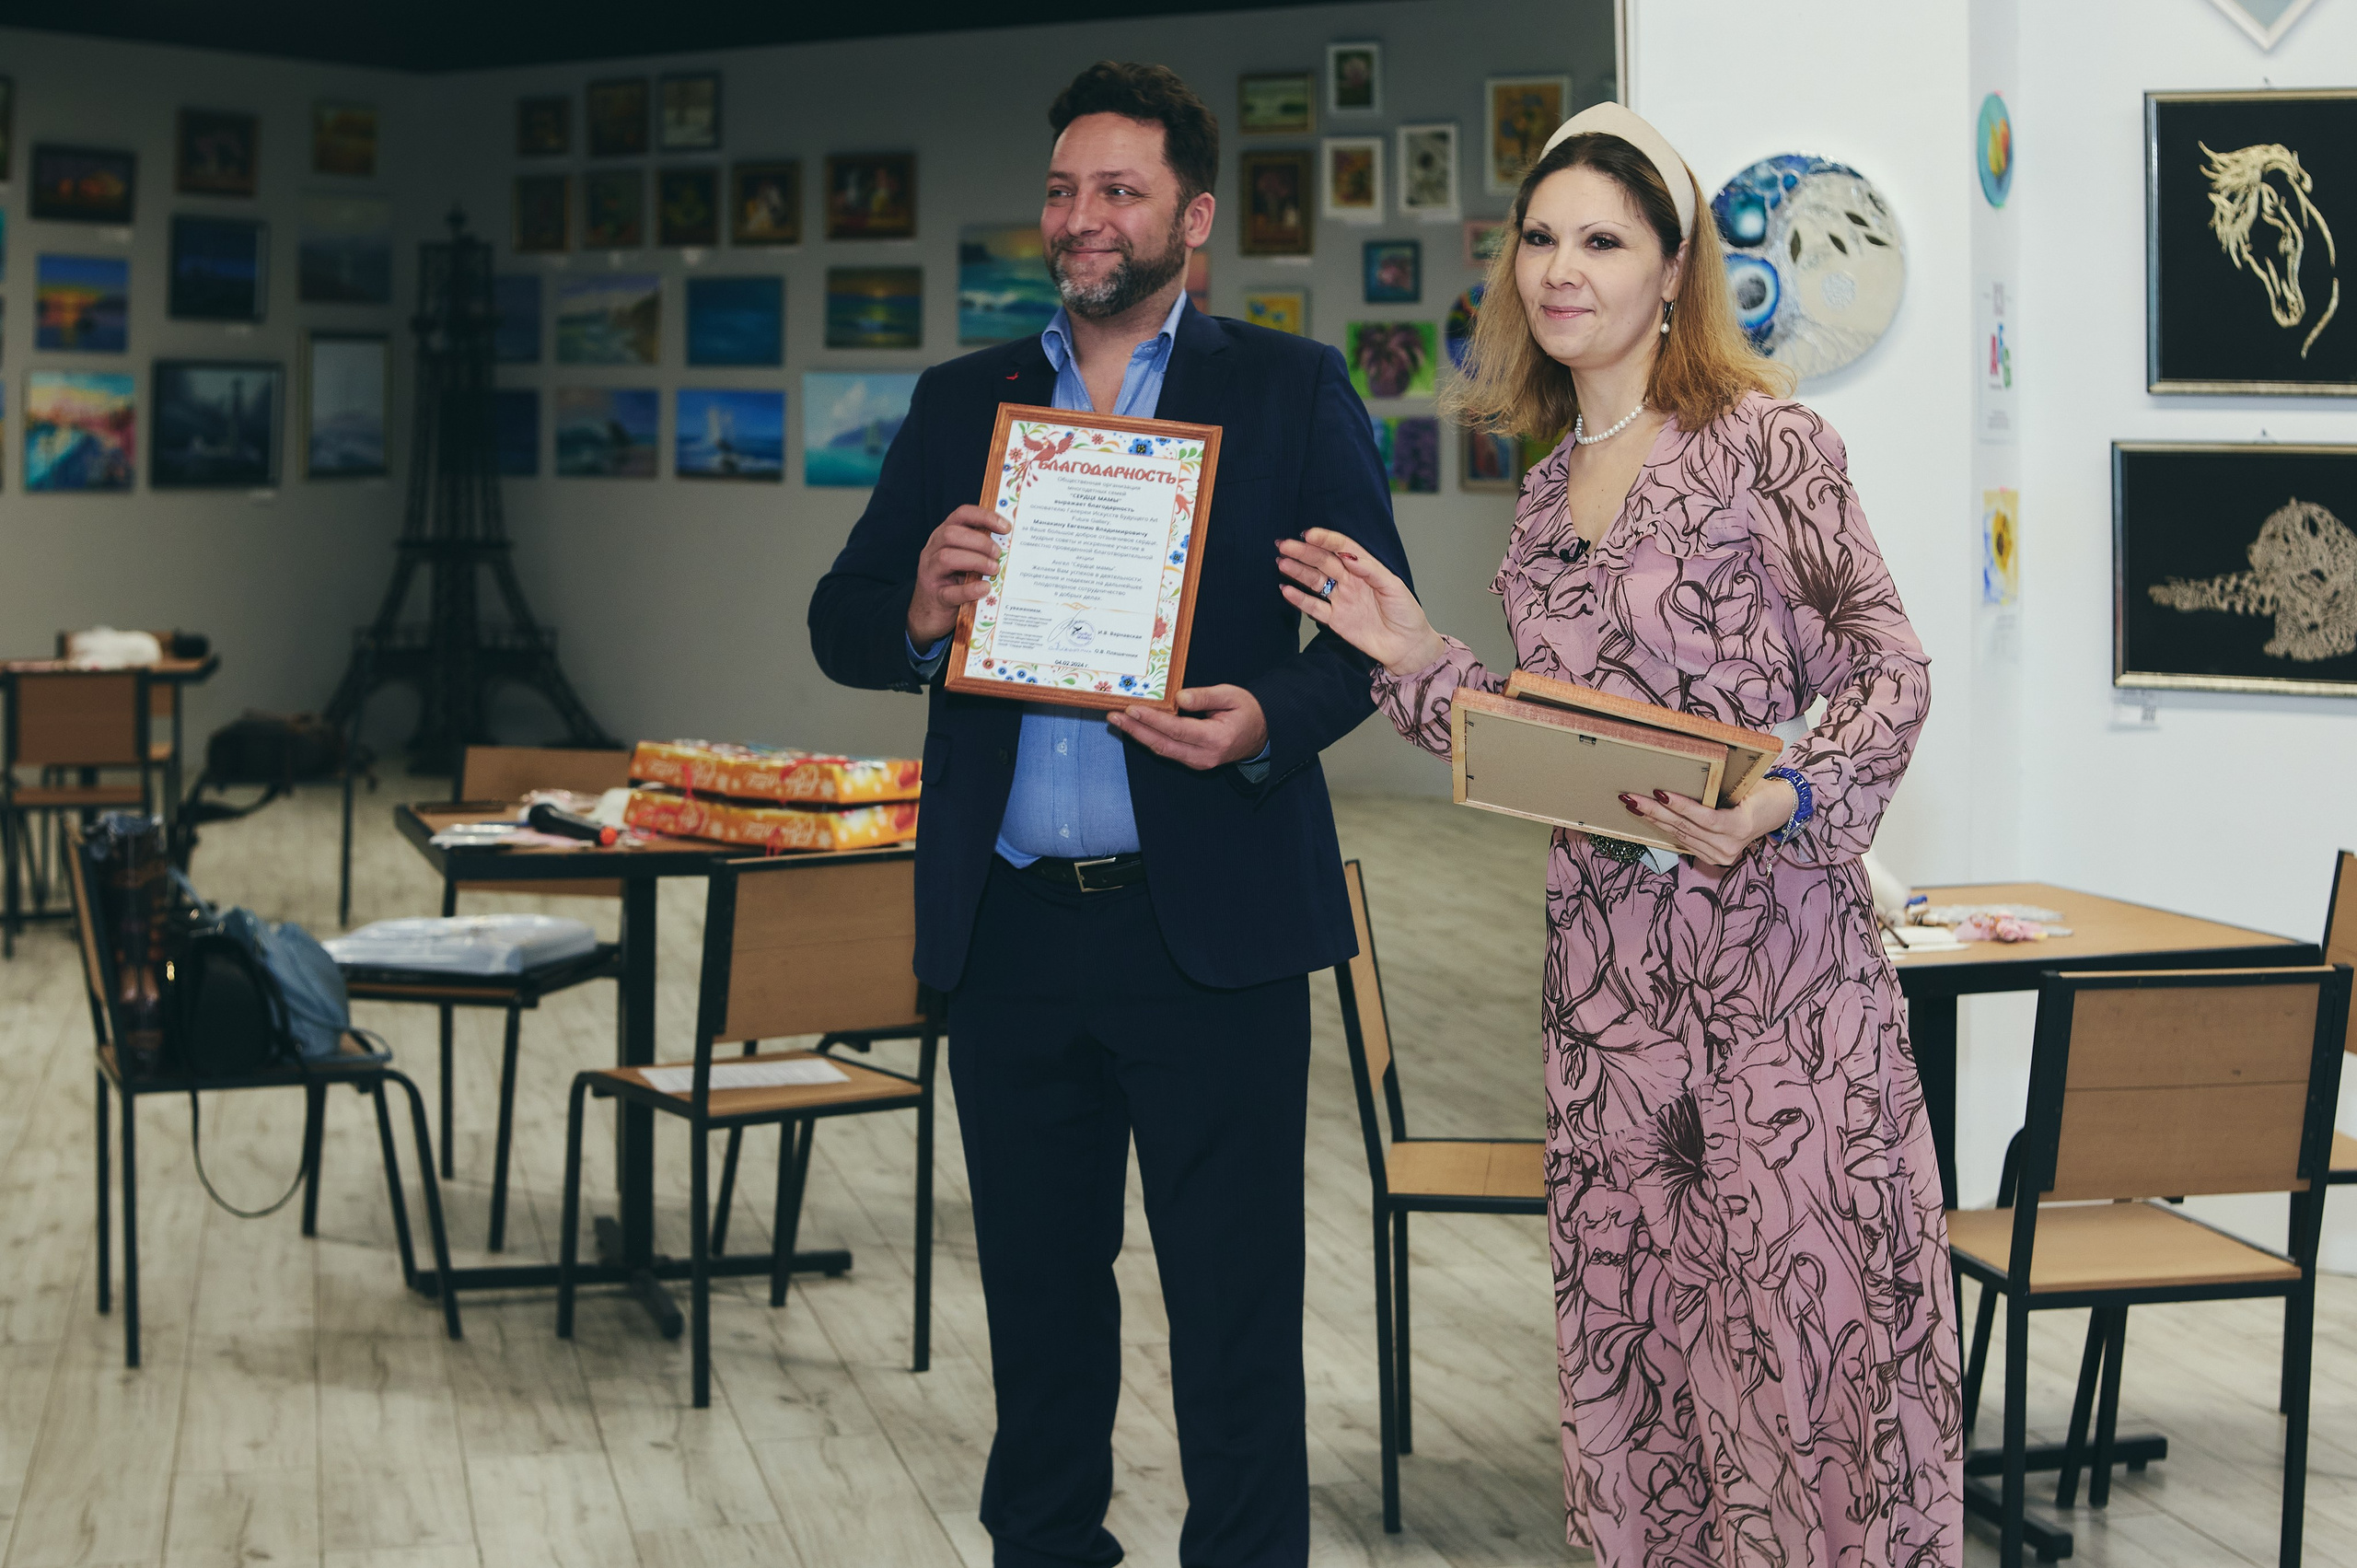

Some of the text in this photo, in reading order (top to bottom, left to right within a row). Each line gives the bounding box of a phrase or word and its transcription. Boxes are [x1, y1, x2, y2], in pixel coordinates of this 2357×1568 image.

[1038, 459, 1177, 484] БЛАГОДАРНОСТЬ
[1057, 476, 1141, 491] Общественная организация
[1067, 507, 1091, 516] Галереи
[1120, 514, 1149, 522] Будущего
[1087, 503, 1134, 512] благодарность
[1096, 527, 1148, 538] Владимировичу
[1019, 572, 1059, 580] процветания
[1033, 581, 1126, 596] плодотворное сотрудничество
